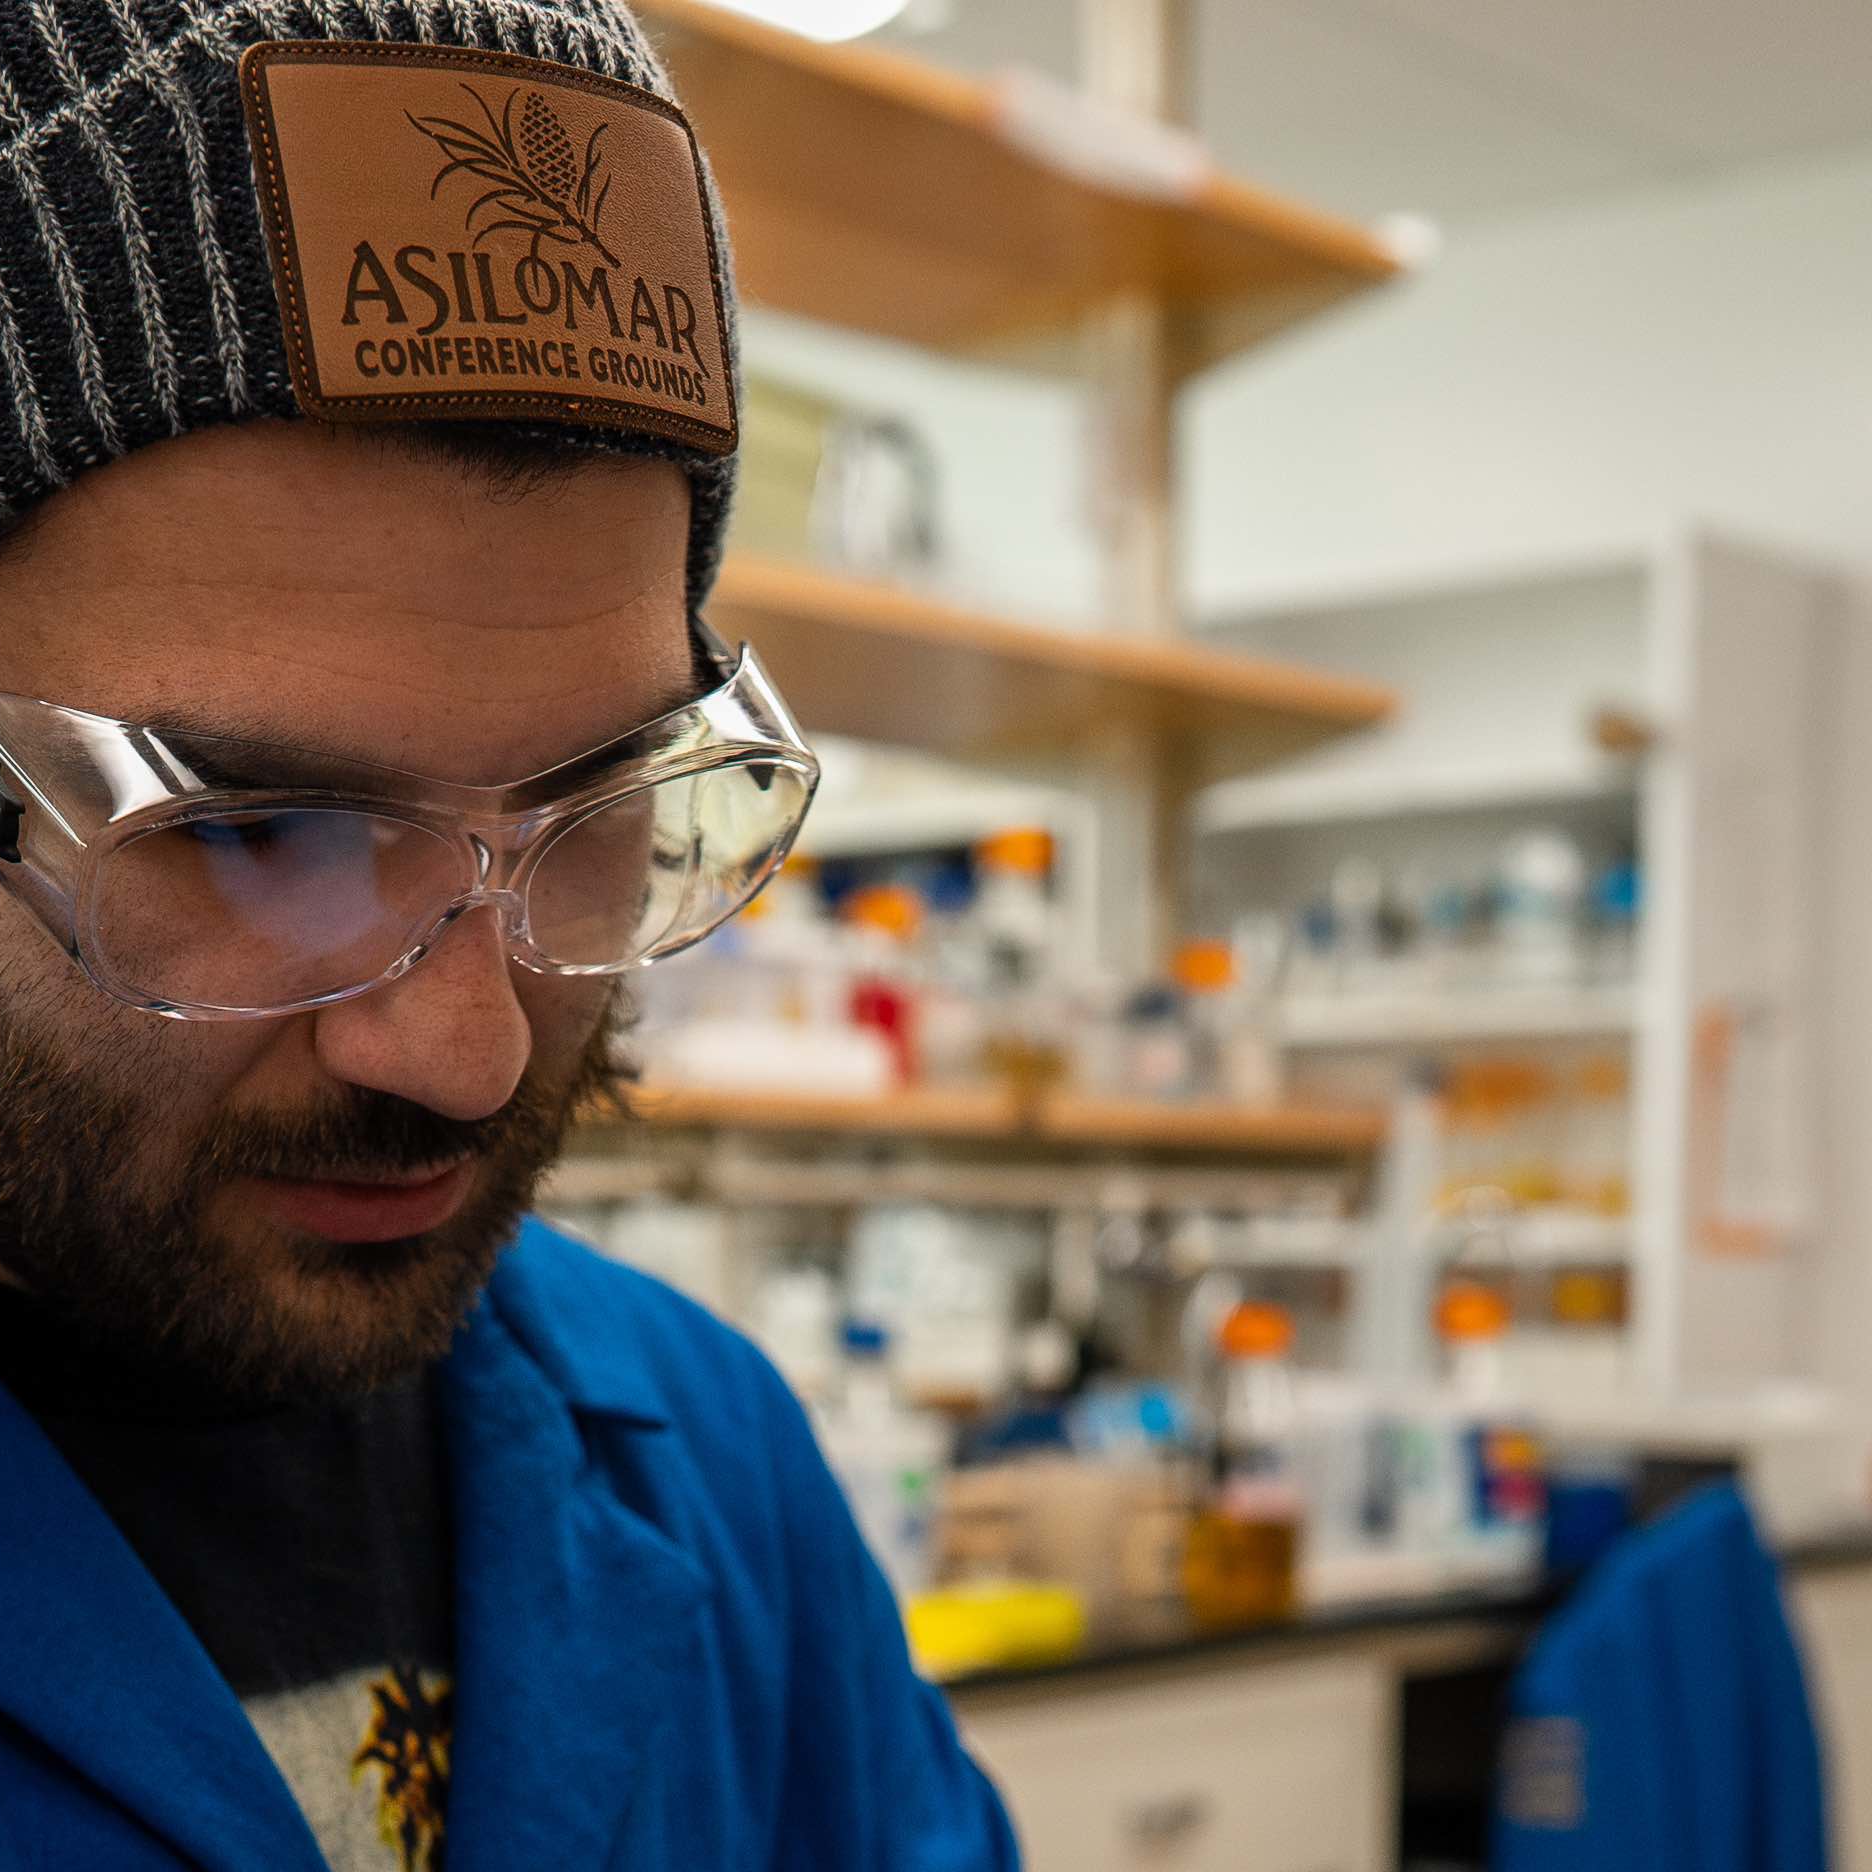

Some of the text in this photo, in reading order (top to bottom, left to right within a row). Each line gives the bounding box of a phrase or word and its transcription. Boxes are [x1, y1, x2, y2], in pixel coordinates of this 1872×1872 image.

[341, 239, 710, 378] ASILOMAR
[355, 334, 707, 406] CONFERENCE GROUNDS
